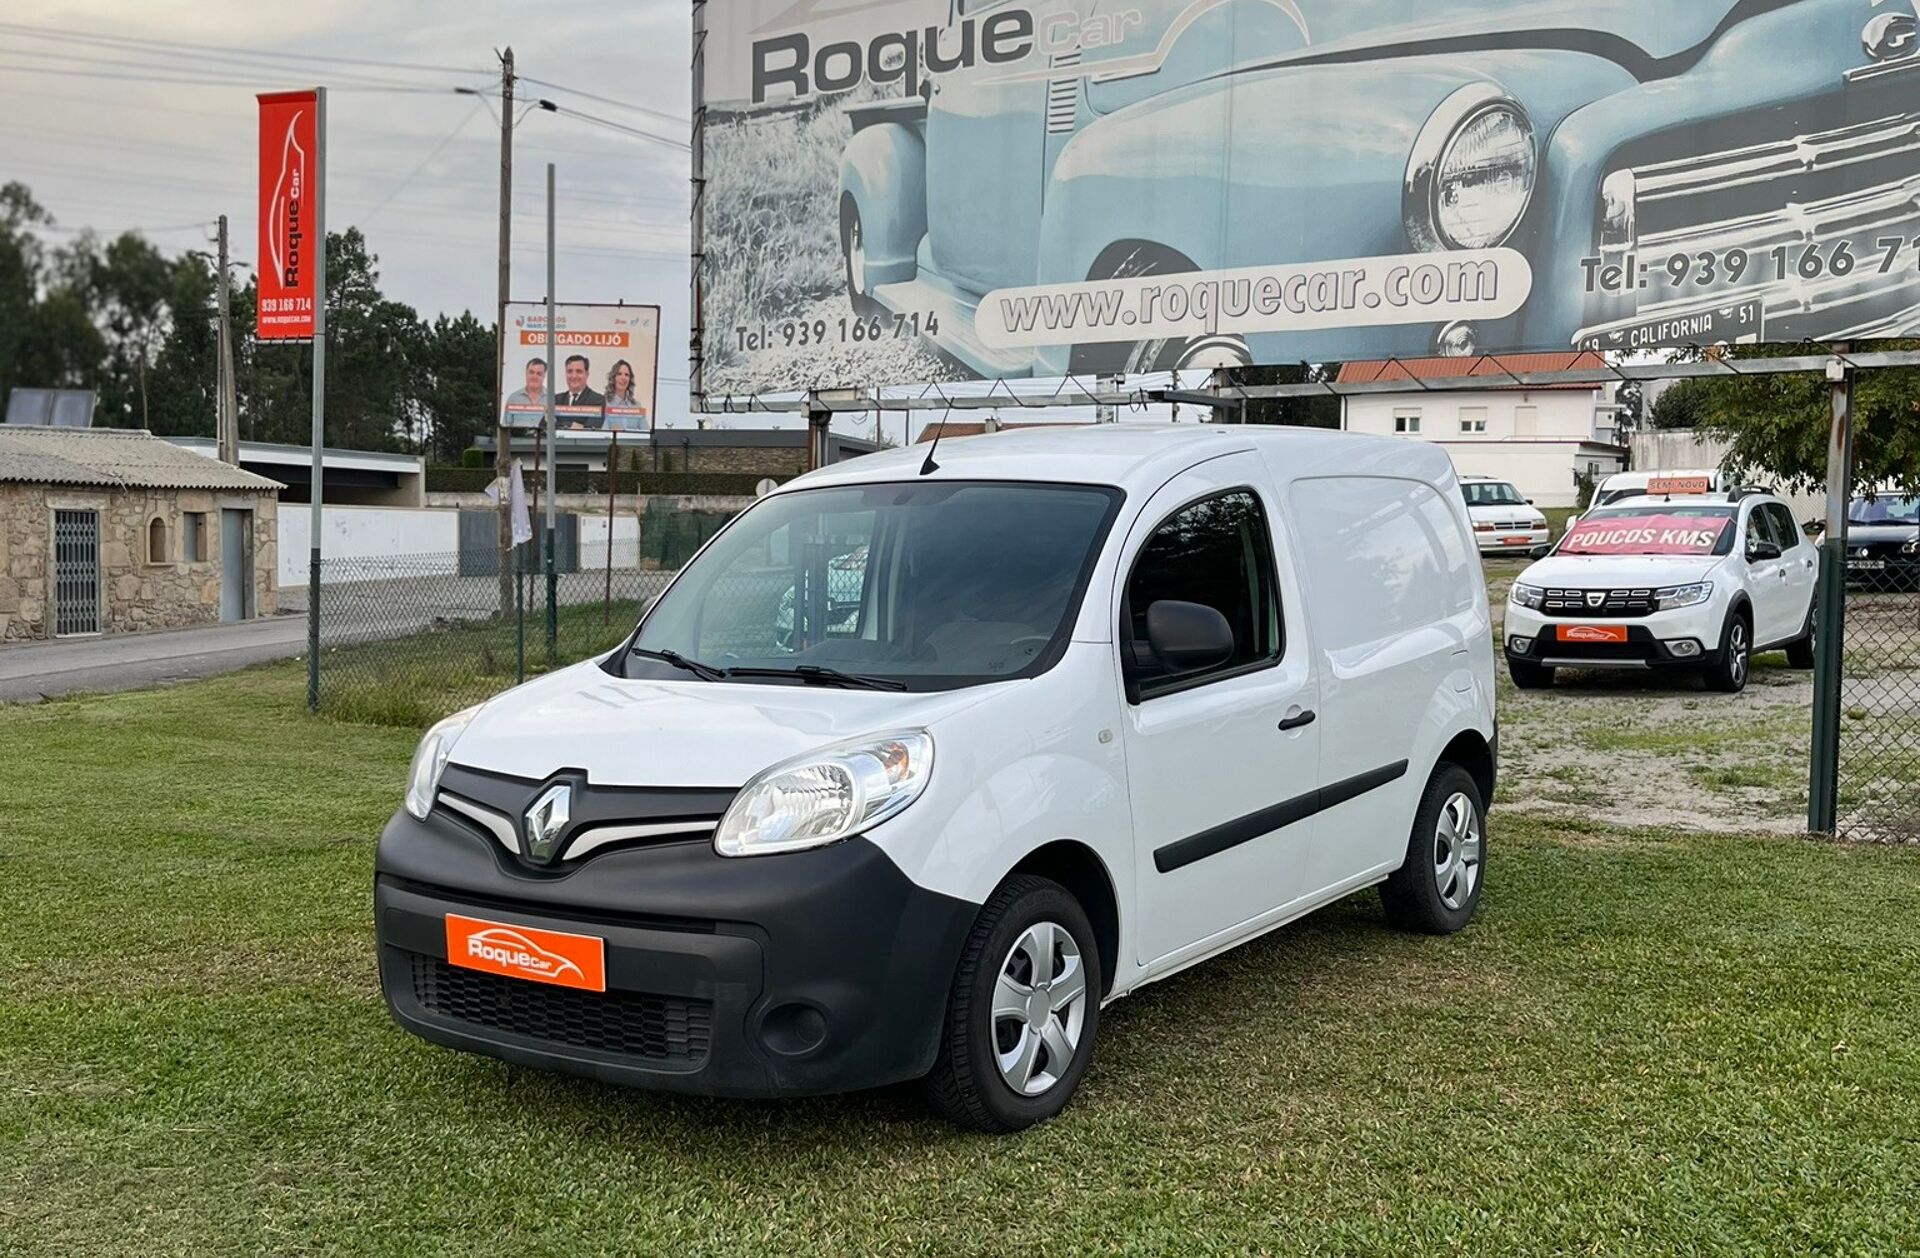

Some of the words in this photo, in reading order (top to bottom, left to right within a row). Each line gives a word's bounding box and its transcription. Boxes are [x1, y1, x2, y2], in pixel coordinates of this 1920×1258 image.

[1580, 254, 1648, 293] Tel:
[1666, 248, 1749, 288] 939
[1771, 239, 1855, 281] 166
[278, 298, 294, 311] 166
[295, 297, 311, 311] 714
[999, 259, 1499, 335] www.roquecar.com
[527, 332, 592, 345] OBIGADO
[735, 324, 773, 352] Tel:
[782, 319, 827, 347] 939
[838, 315, 882, 343] 166
[892, 310, 940, 339] 714
[1630, 313, 1713, 347] CALIFORNIA
[1739, 304, 1754, 324] 51
[1678, 481, 1706, 489] NOVO
[1567, 528, 1657, 549] POUCOS
[1658, 529, 1716, 547] KMS
